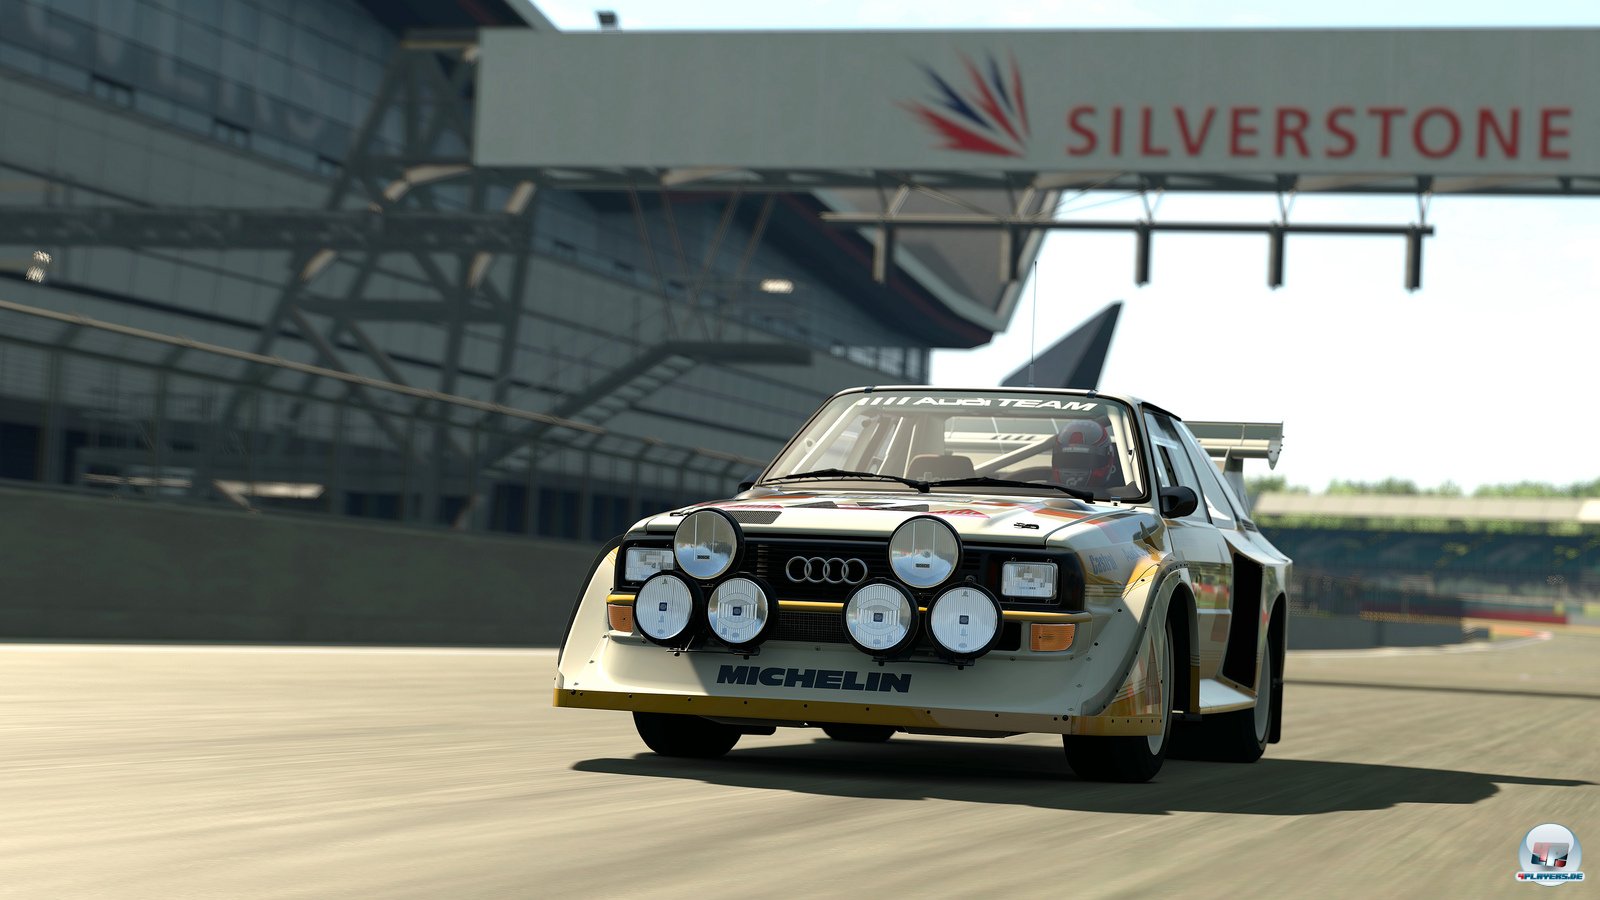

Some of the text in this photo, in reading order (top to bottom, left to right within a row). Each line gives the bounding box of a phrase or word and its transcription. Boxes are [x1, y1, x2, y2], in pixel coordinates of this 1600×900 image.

[1066, 106, 1573, 160] SILVERSTONE
[998, 398, 1098, 412] TEAM
[716, 665, 912, 693] MICHELIN
